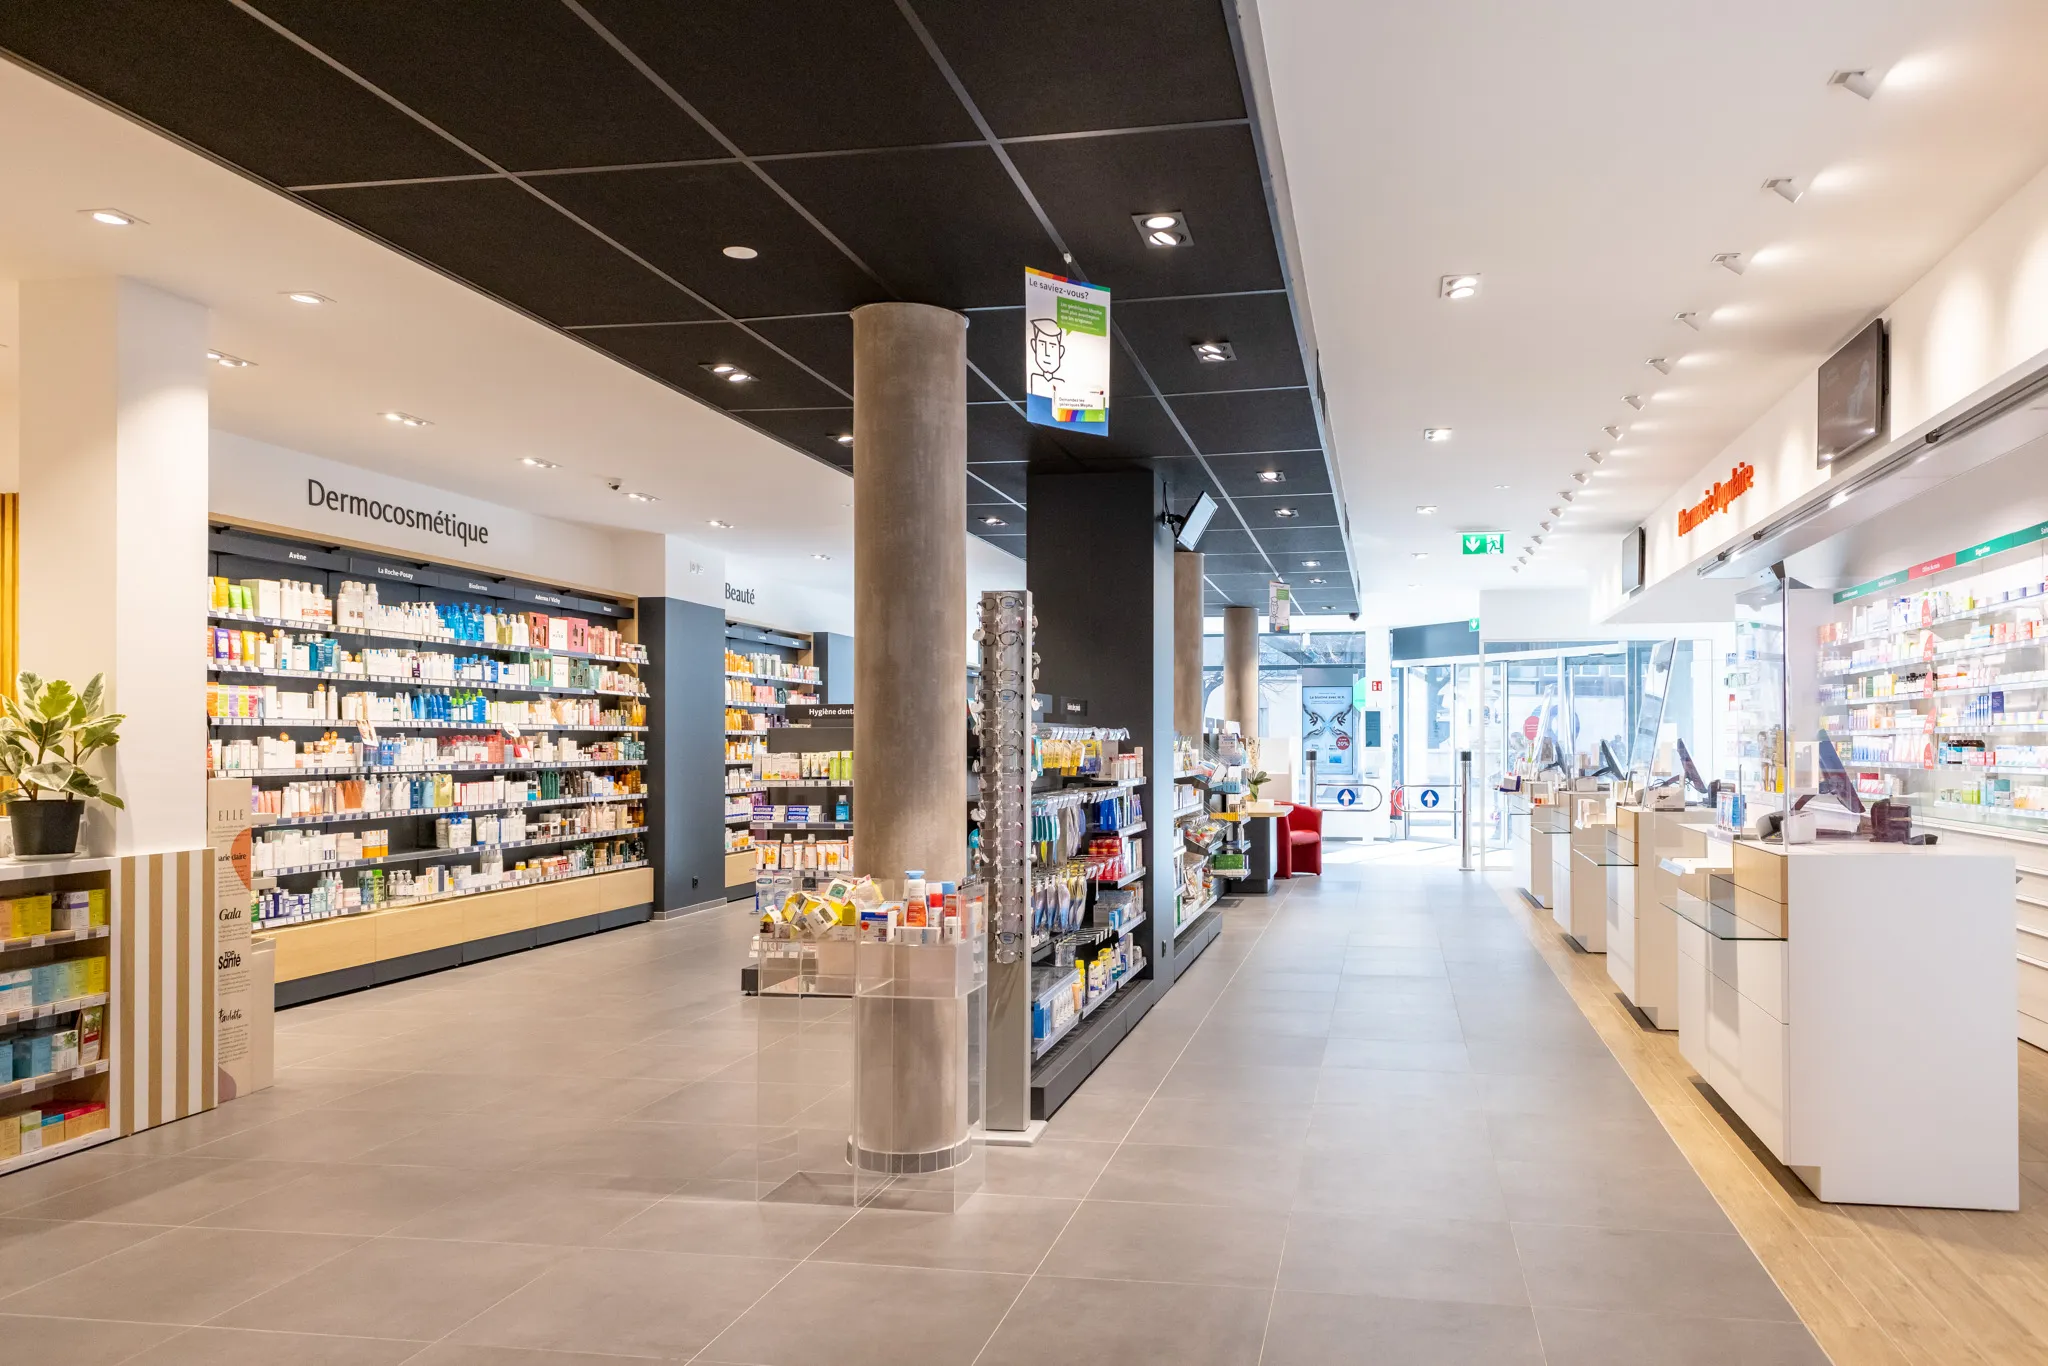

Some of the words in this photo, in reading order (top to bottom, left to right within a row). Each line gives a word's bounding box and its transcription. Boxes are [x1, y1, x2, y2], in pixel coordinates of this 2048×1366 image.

[1029, 277, 1038, 288] Le
[1039, 281, 1089, 300] saviez-vous?
[307, 478, 489, 548] Dermocosmétique
[288, 552, 307, 561] Avène
[384, 568, 414, 580] Roche-Posay
[468, 582, 488, 592] Bioderma
[724, 582, 755, 605] Beauté
[808, 708, 836, 716] Hygiène
[218, 808, 244, 822] ELLE
[231, 852, 247, 860] claire
[219, 908, 241, 920] Gala
[218, 954, 241, 970] Santé
